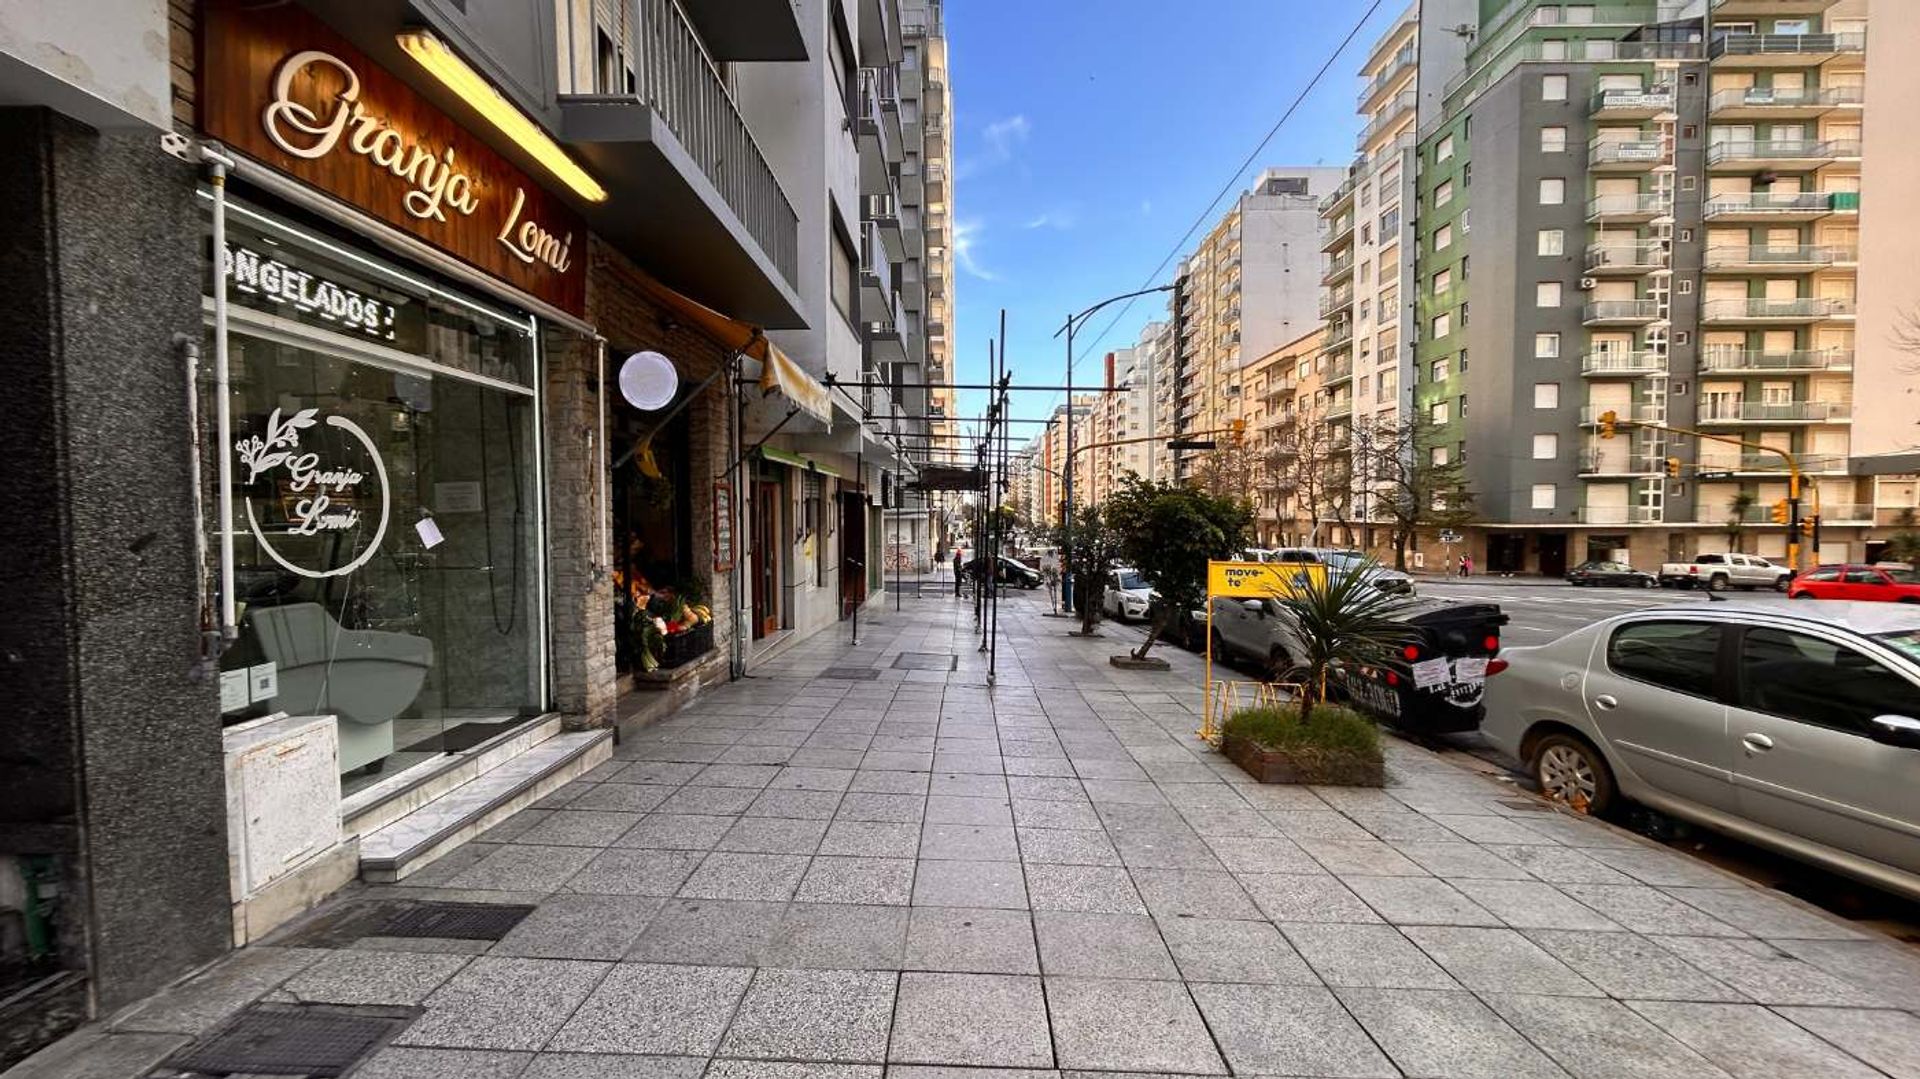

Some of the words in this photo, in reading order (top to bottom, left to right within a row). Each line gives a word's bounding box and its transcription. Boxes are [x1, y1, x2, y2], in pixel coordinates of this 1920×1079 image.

[265, 51, 479, 222] Granja
[497, 187, 572, 273] Lomi
[285, 453, 363, 492] Granja
[288, 495, 357, 536] Lomi
[1225, 569, 1263, 577] move-
